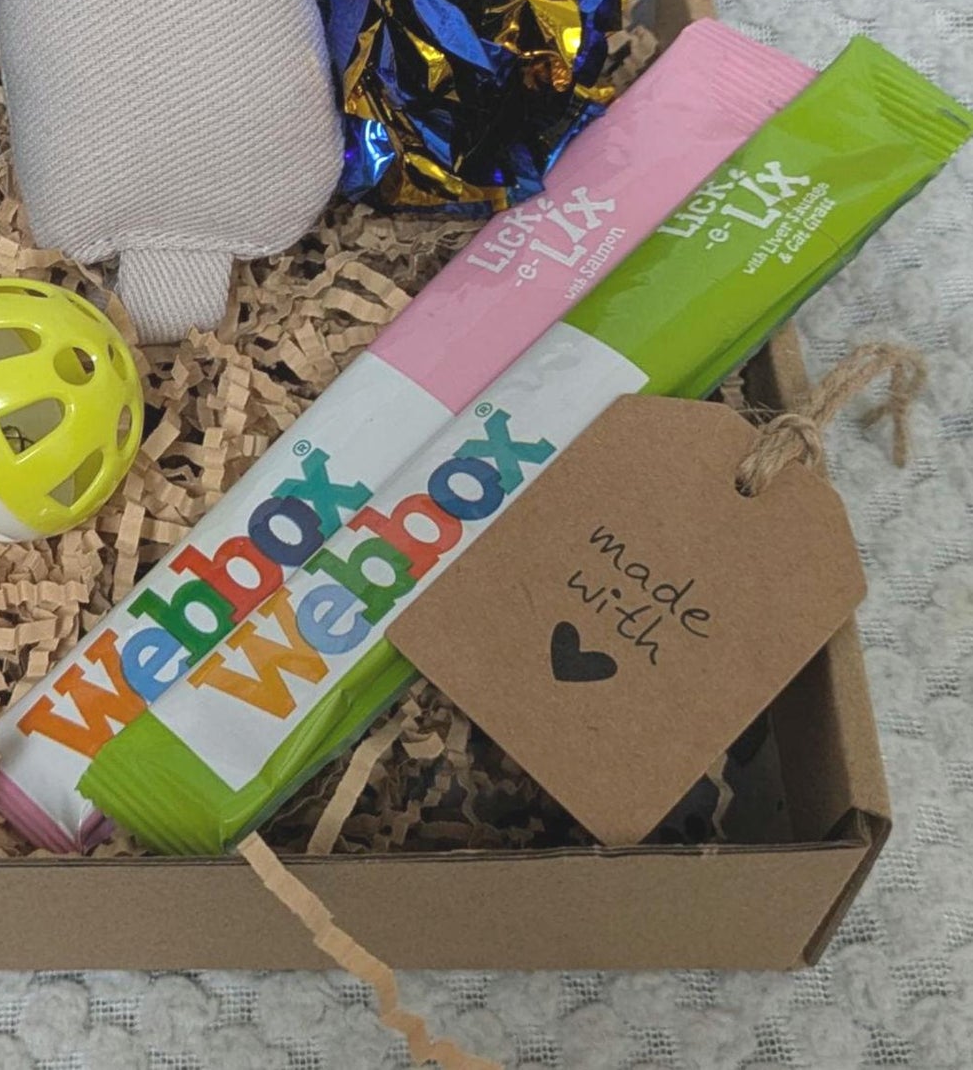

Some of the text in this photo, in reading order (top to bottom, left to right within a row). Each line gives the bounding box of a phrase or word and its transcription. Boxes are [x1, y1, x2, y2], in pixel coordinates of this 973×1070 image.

[579, 227, 626, 279] Salmon
[742, 181, 831, 276] with Liver Sausage
[778, 196, 837, 264] & Cat Grass
[567, 570, 663, 666] with
[589, 525, 711, 639] made
